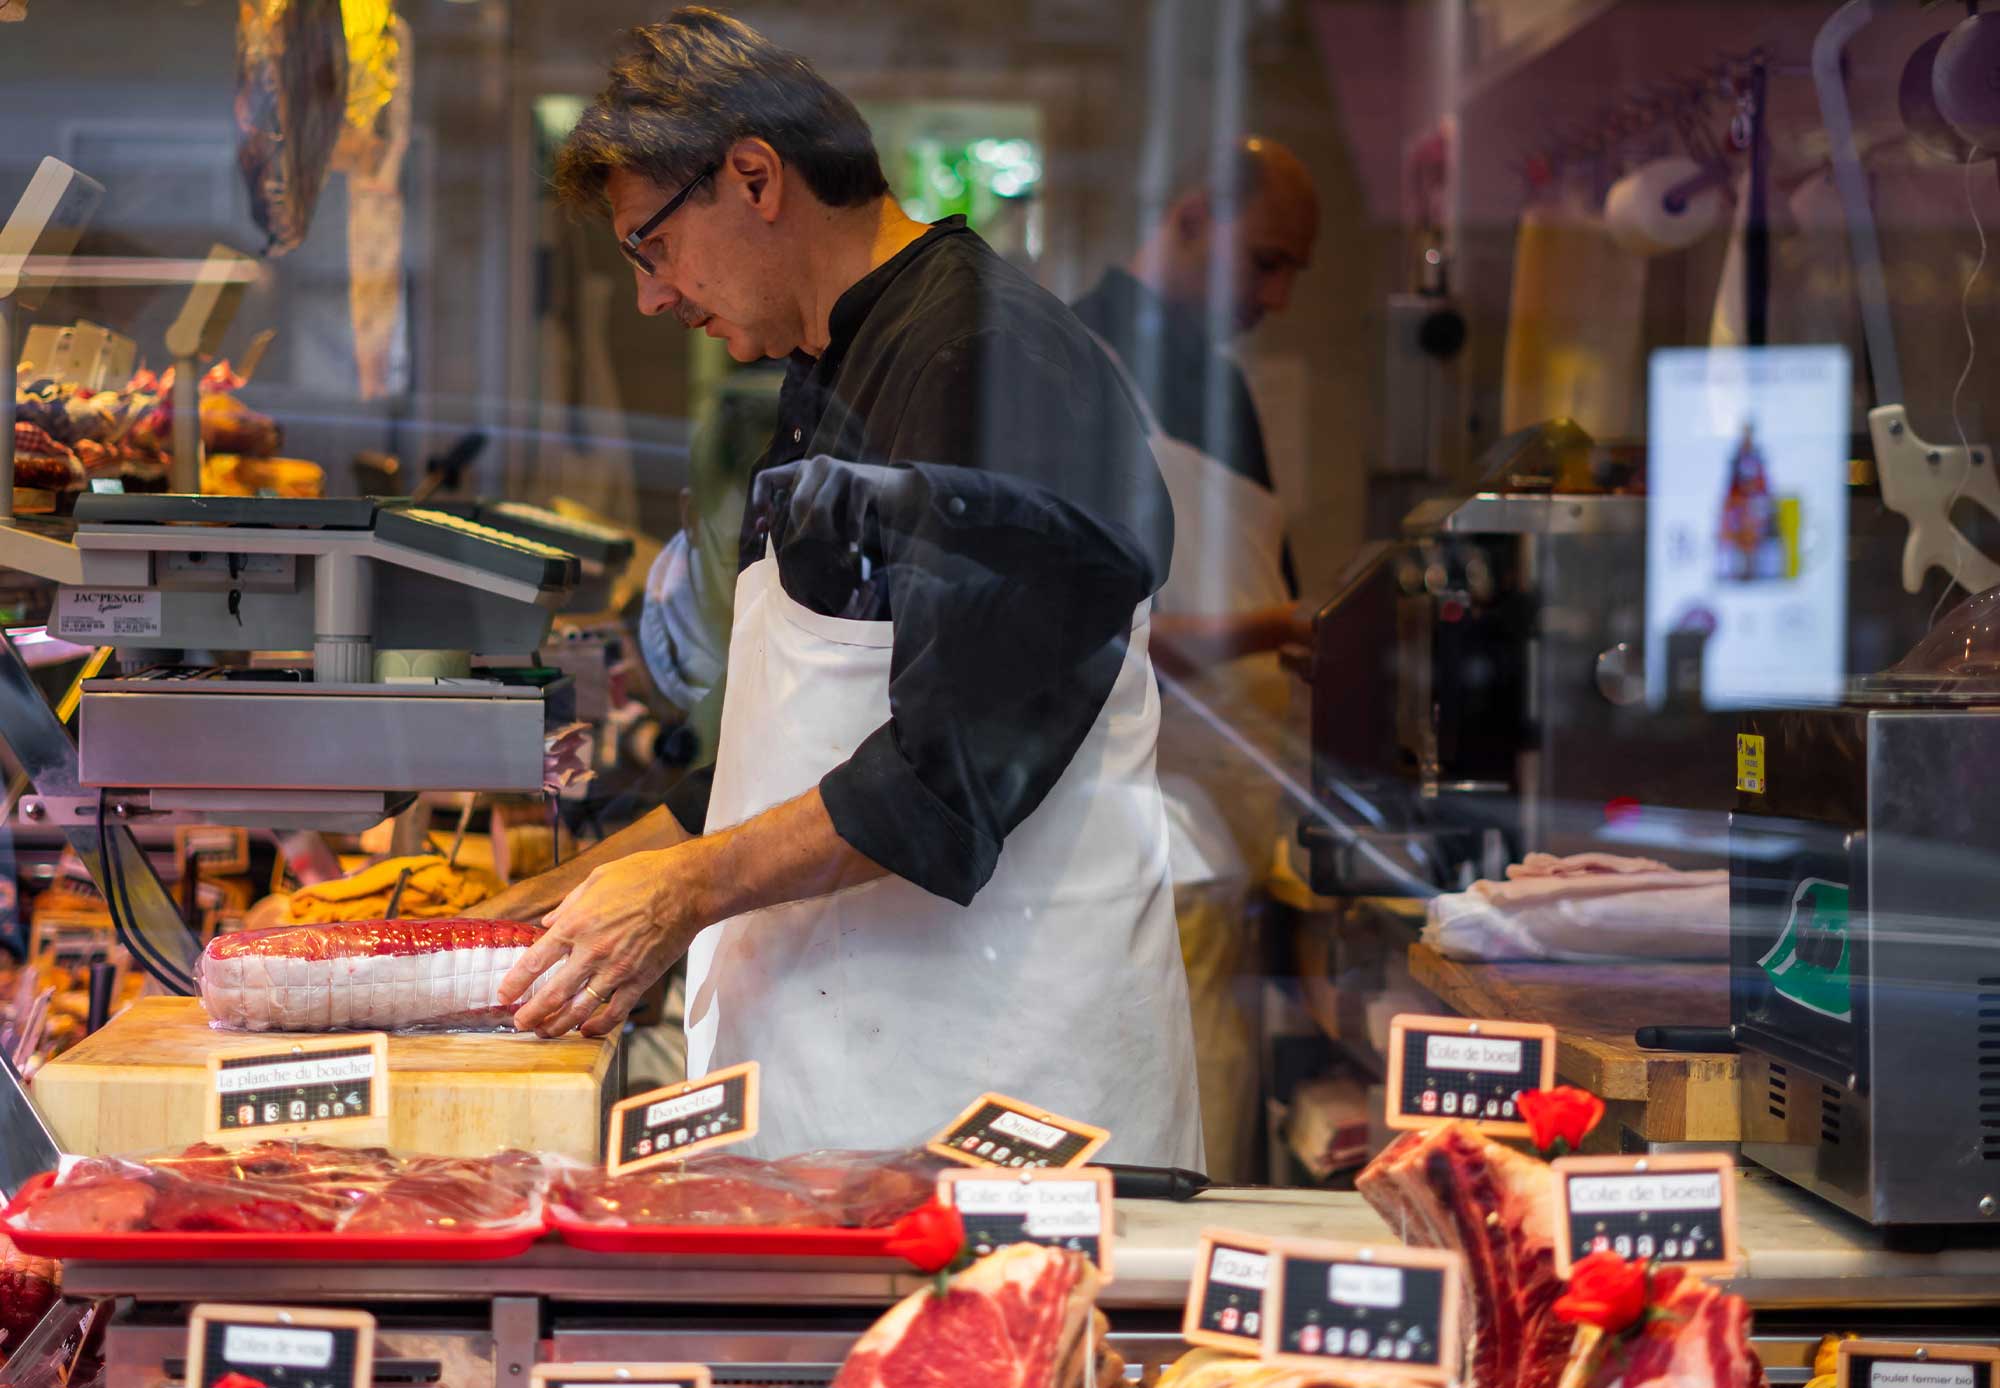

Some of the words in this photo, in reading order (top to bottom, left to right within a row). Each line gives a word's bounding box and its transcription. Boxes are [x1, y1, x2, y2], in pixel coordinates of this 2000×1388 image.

[1464, 1047, 1480, 1061] de
[237, 1068, 291, 1088] planche
[296, 1065, 311, 1080] du
[316, 1060, 371, 1078] boucher
[1008, 1185, 1032, 1202] de
[1629, 1184, 1654, 1201] de
[1661, 1181, 1717, 1200] boeuf
[1872, 1372, 1909, 1384] Poulet
[1913, 1374, 1952, 1386] fermier
[1955, 1375, 1973, 1386] bio
